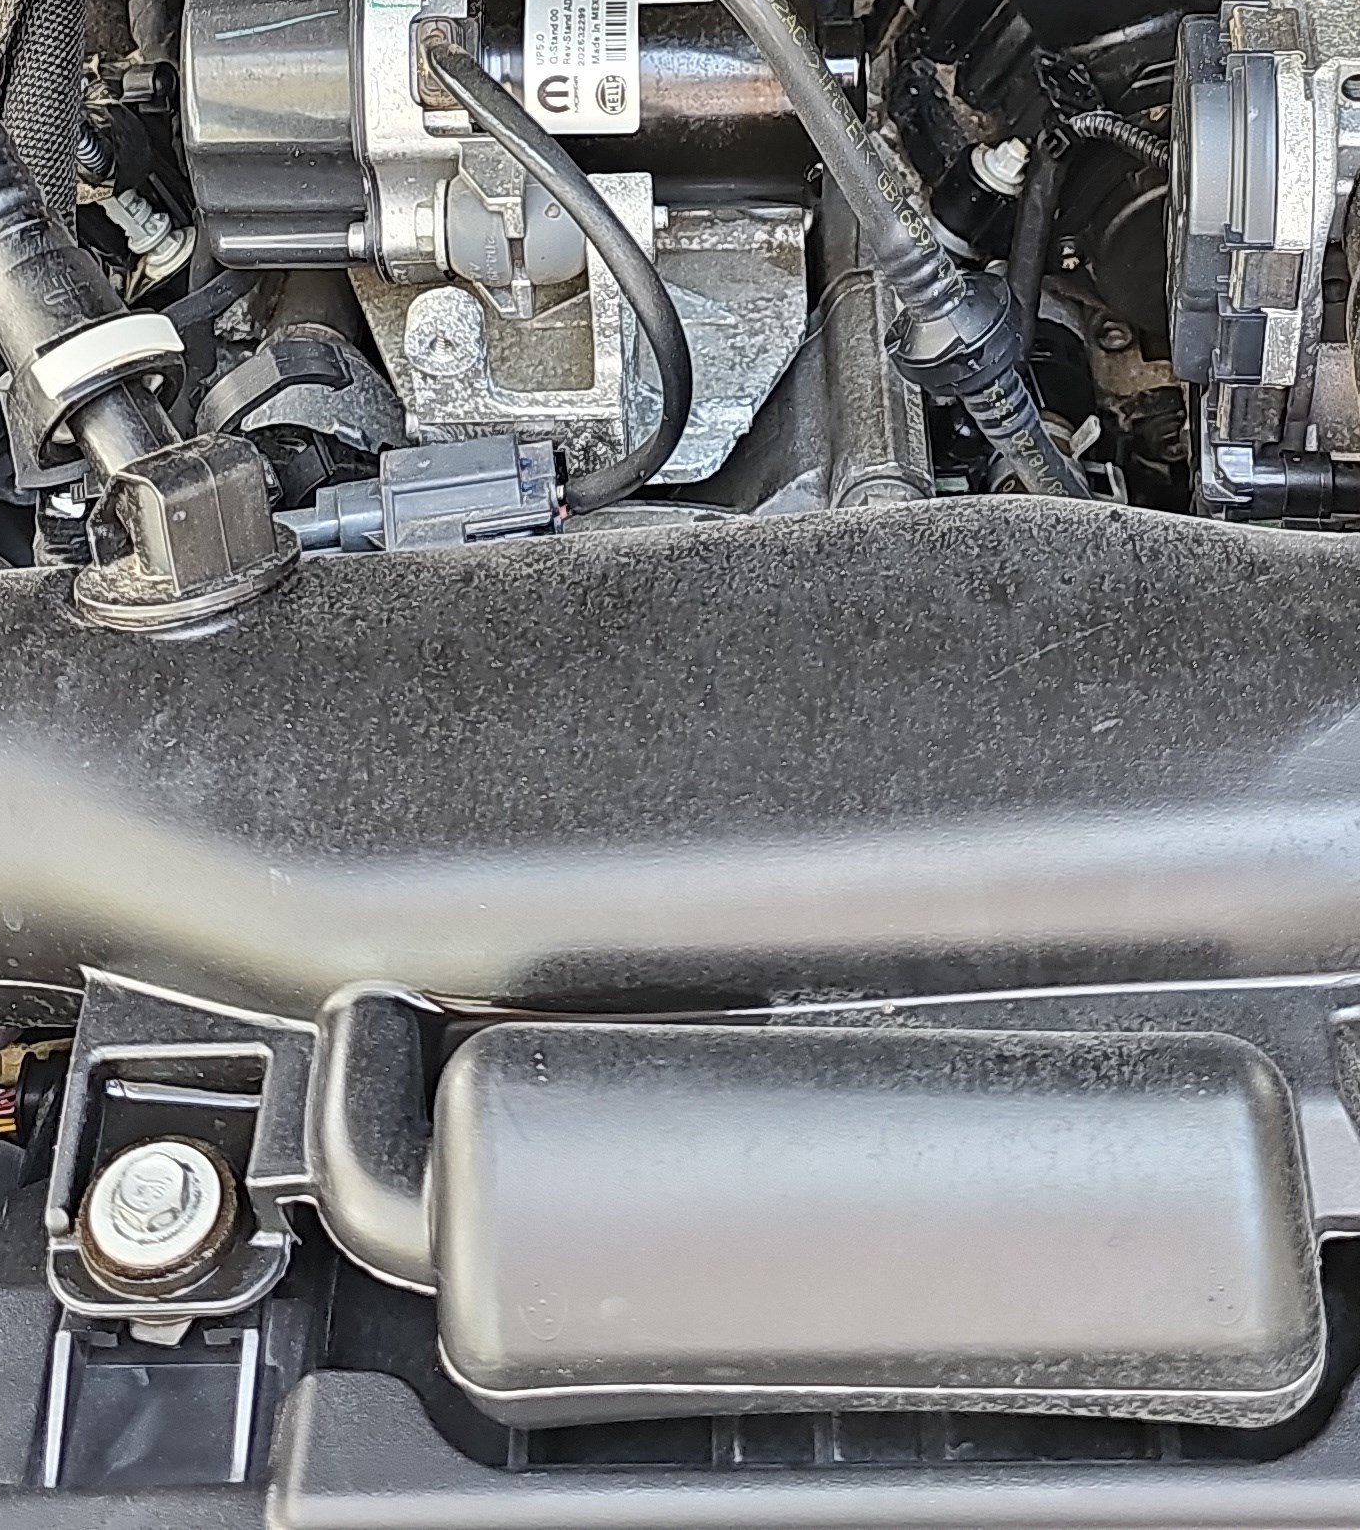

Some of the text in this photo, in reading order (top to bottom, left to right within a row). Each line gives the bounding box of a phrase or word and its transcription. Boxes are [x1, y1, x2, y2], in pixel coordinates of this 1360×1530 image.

[535, 33, 545, 66] UP5.0
[562, 13, 573, 65] Rev-Stand
[591, 37, 601, 65] Made
[605, 74, 621, 113] HELLA
